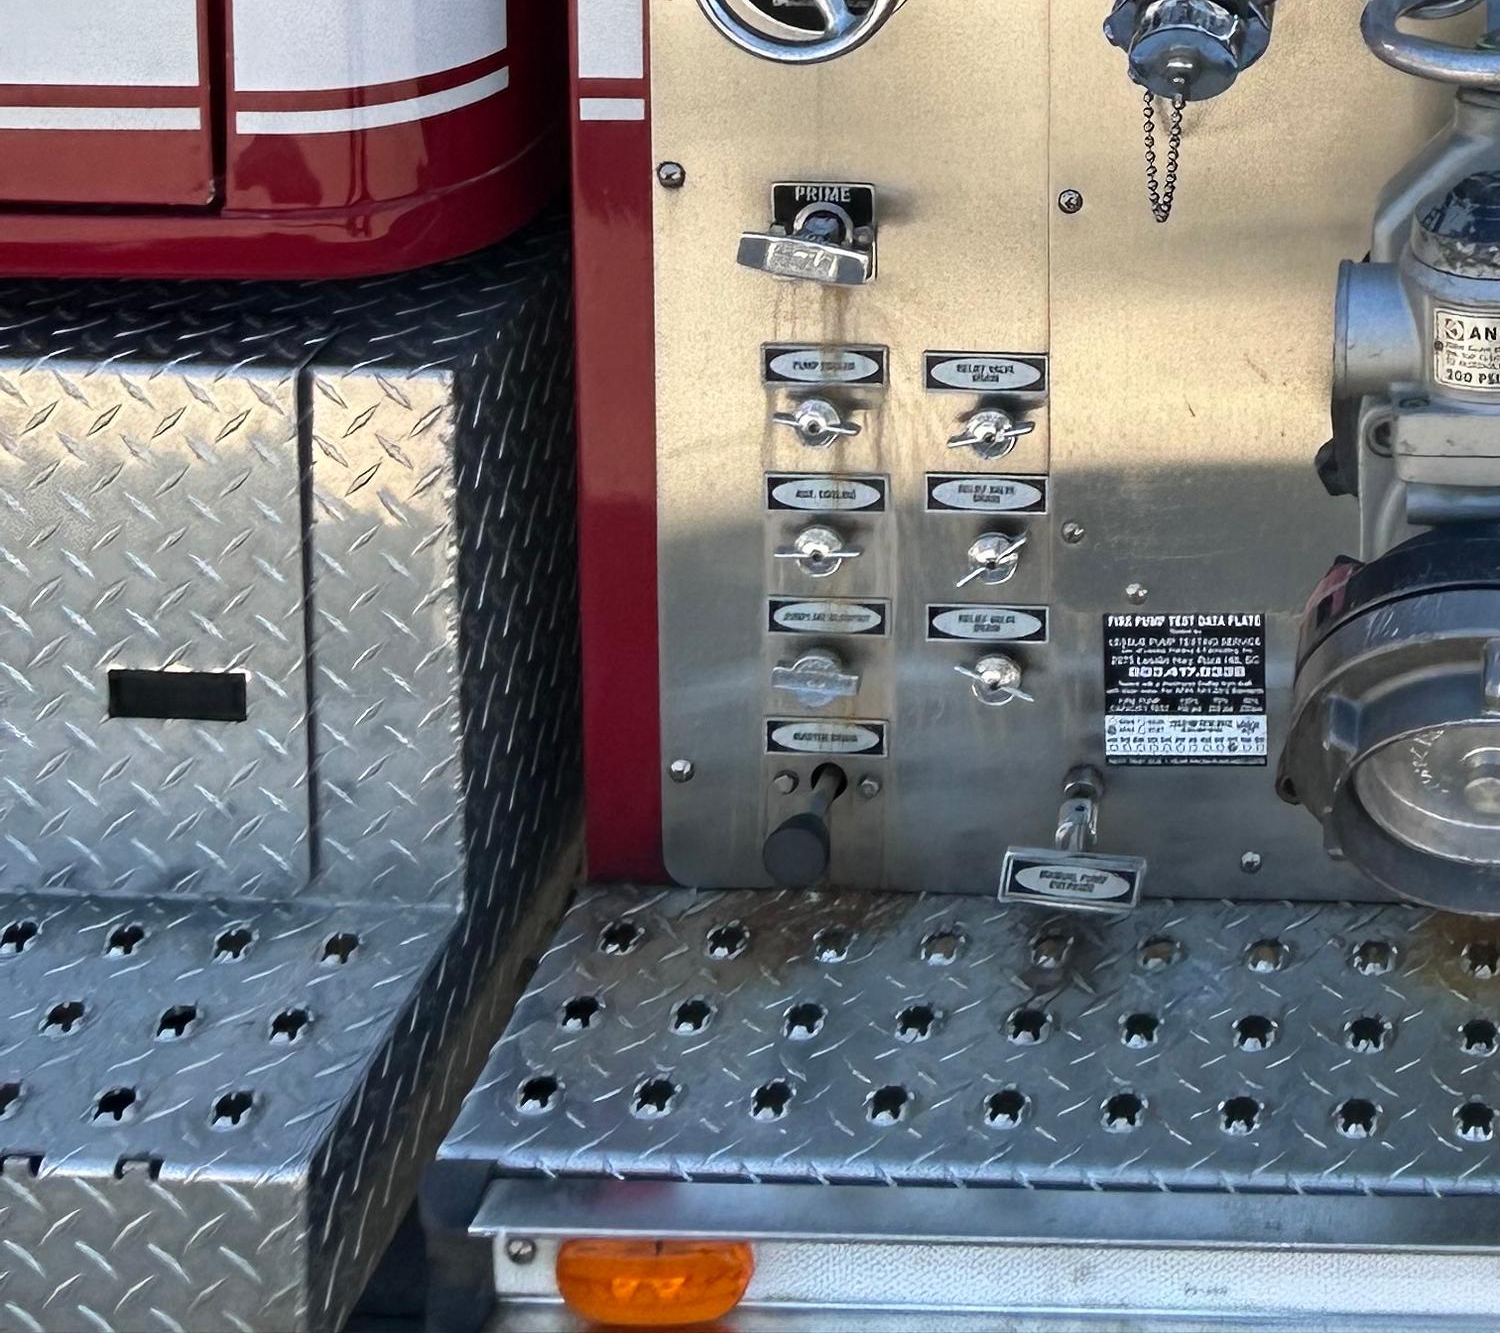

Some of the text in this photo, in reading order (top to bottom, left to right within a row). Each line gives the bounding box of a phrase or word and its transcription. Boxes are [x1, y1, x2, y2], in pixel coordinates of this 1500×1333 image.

[795, 187, 851, 202] PRIME
[1108, 615, 1260, 627] FIRE PUMP TEST DATA PLATE
